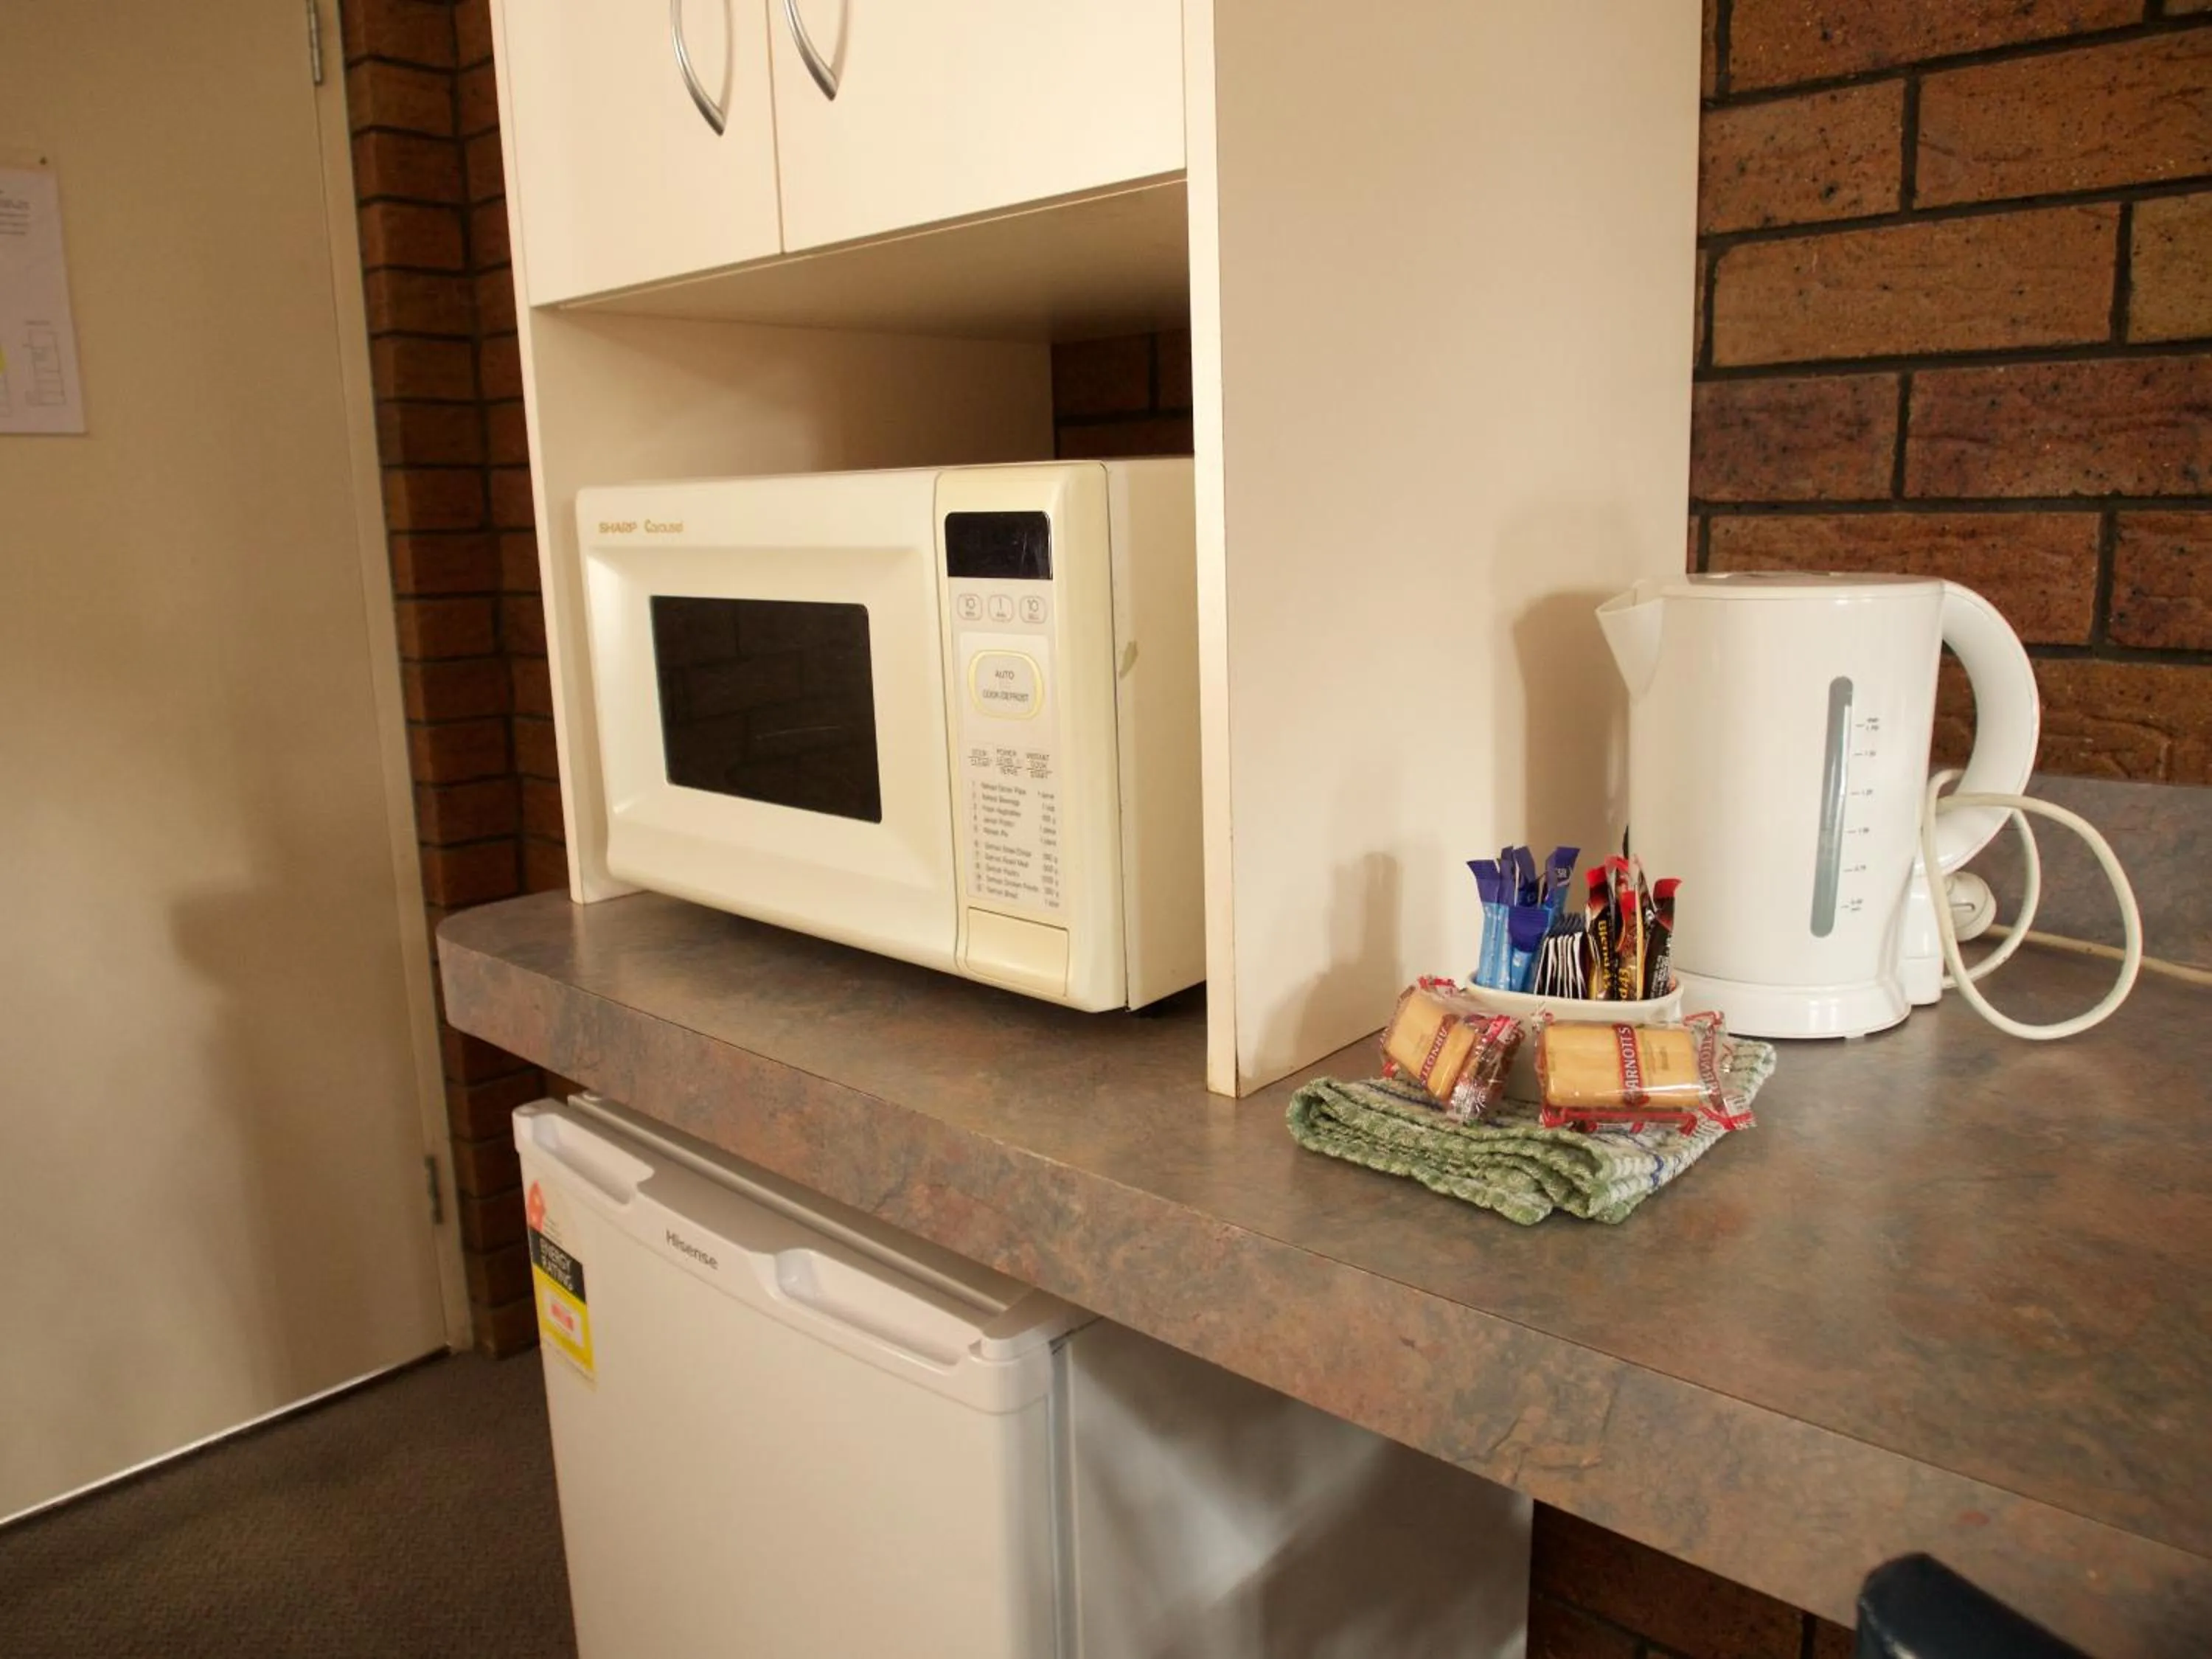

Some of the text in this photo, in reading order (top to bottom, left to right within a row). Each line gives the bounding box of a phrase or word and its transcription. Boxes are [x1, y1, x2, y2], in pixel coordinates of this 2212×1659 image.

[599, 522, 638, 533] SHARP
[965, 597, 975, 610] 10
[1027, 599, 1040, 613] 10
[995, 669, 1015, 681] AUTO
[1598, 919, 1610, 967] Blend
[665, 1229, 719, 1270] Hisense
